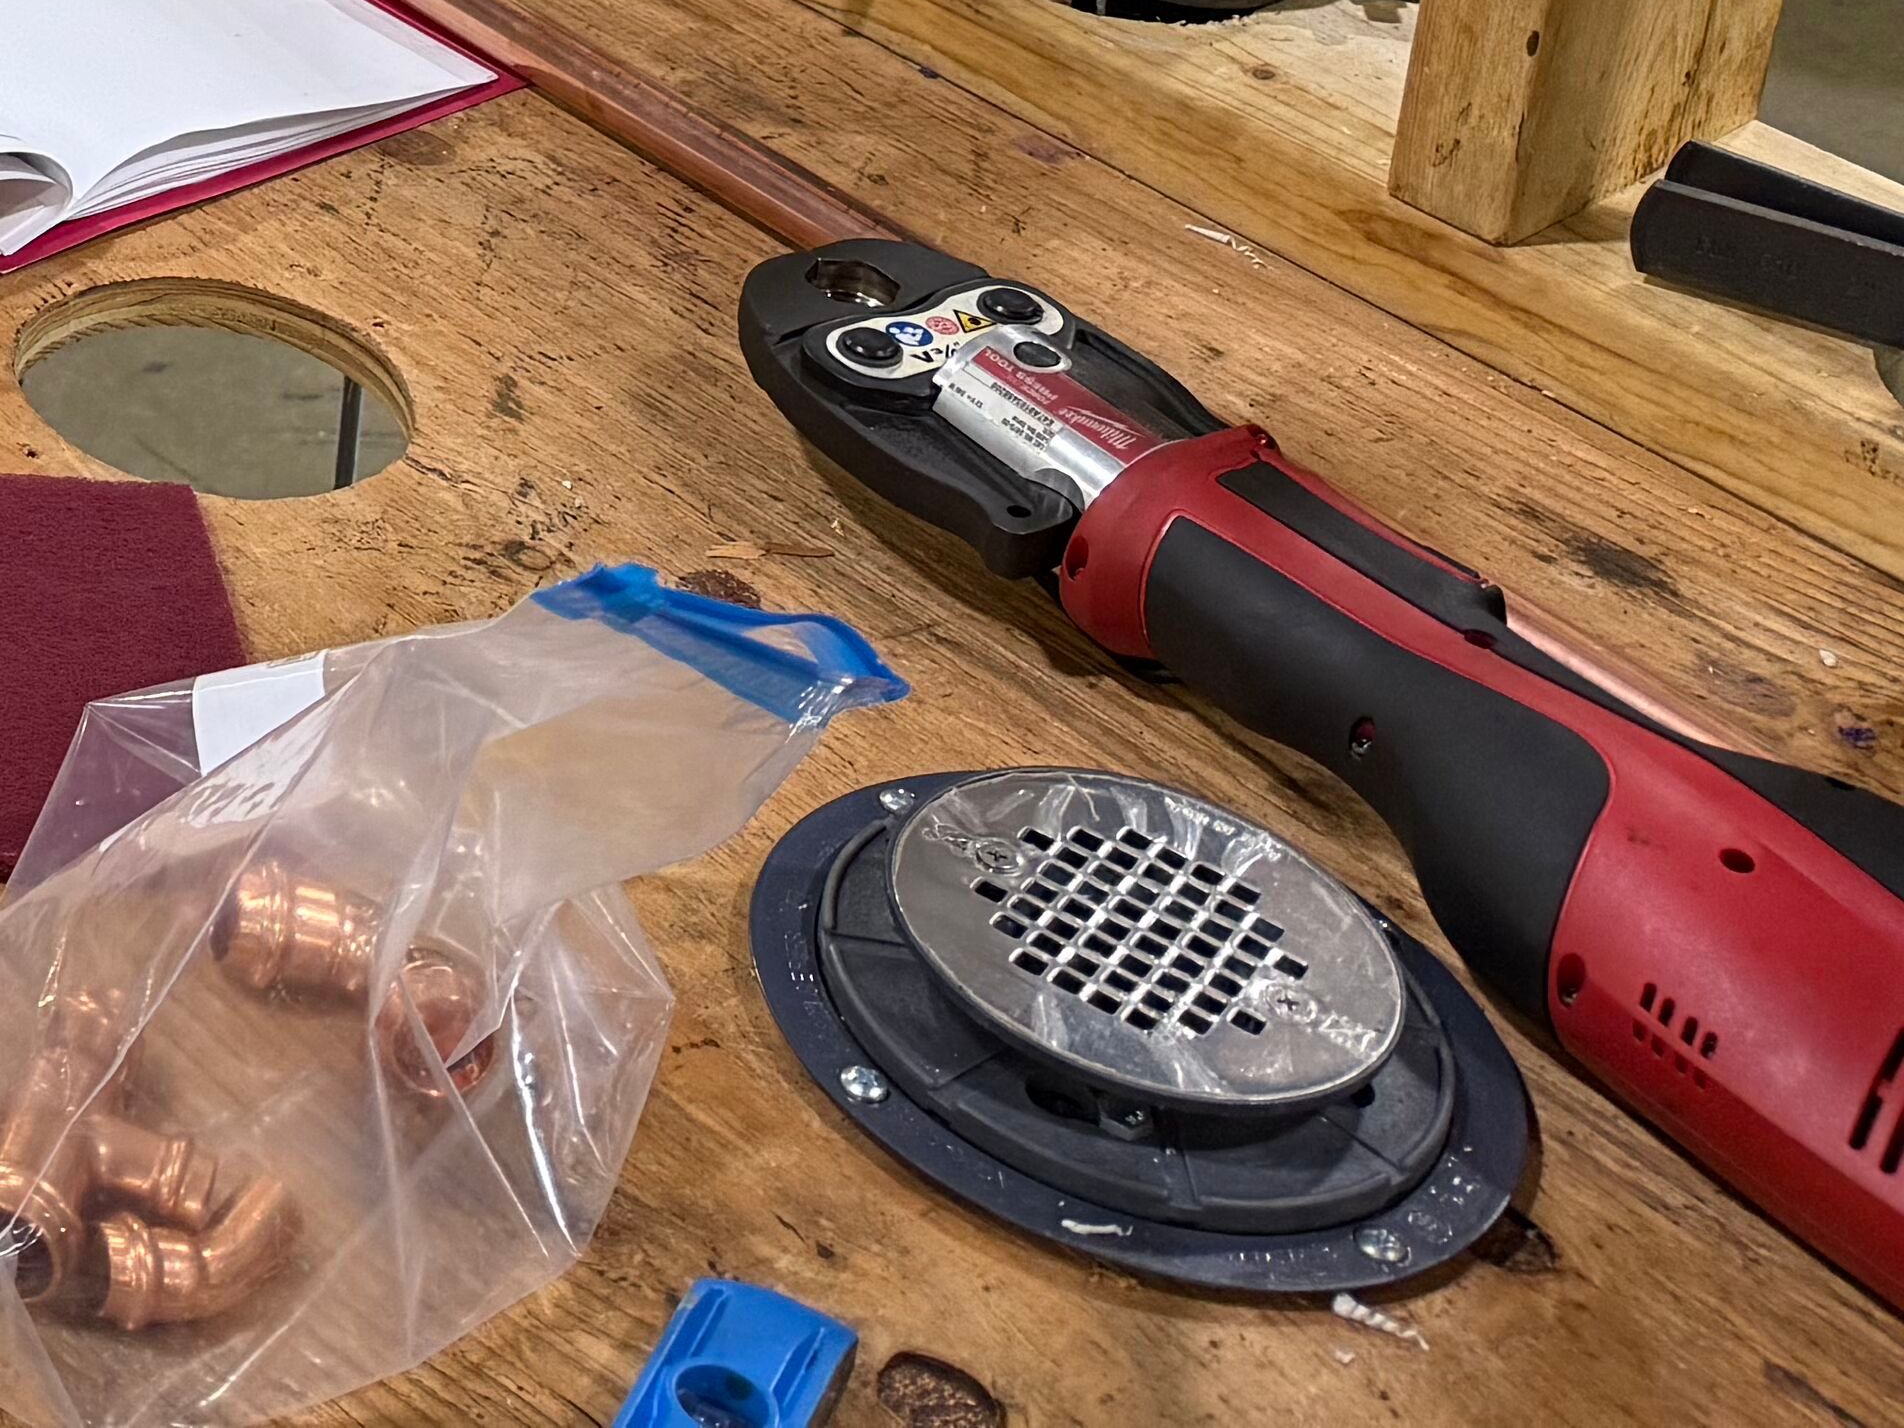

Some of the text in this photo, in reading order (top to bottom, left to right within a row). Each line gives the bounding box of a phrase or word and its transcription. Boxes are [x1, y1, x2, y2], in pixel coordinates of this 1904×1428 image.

[982, 347, 1060, 402] PRESS TOOL
[1056, 406, 1138, 450] Milwaukee
